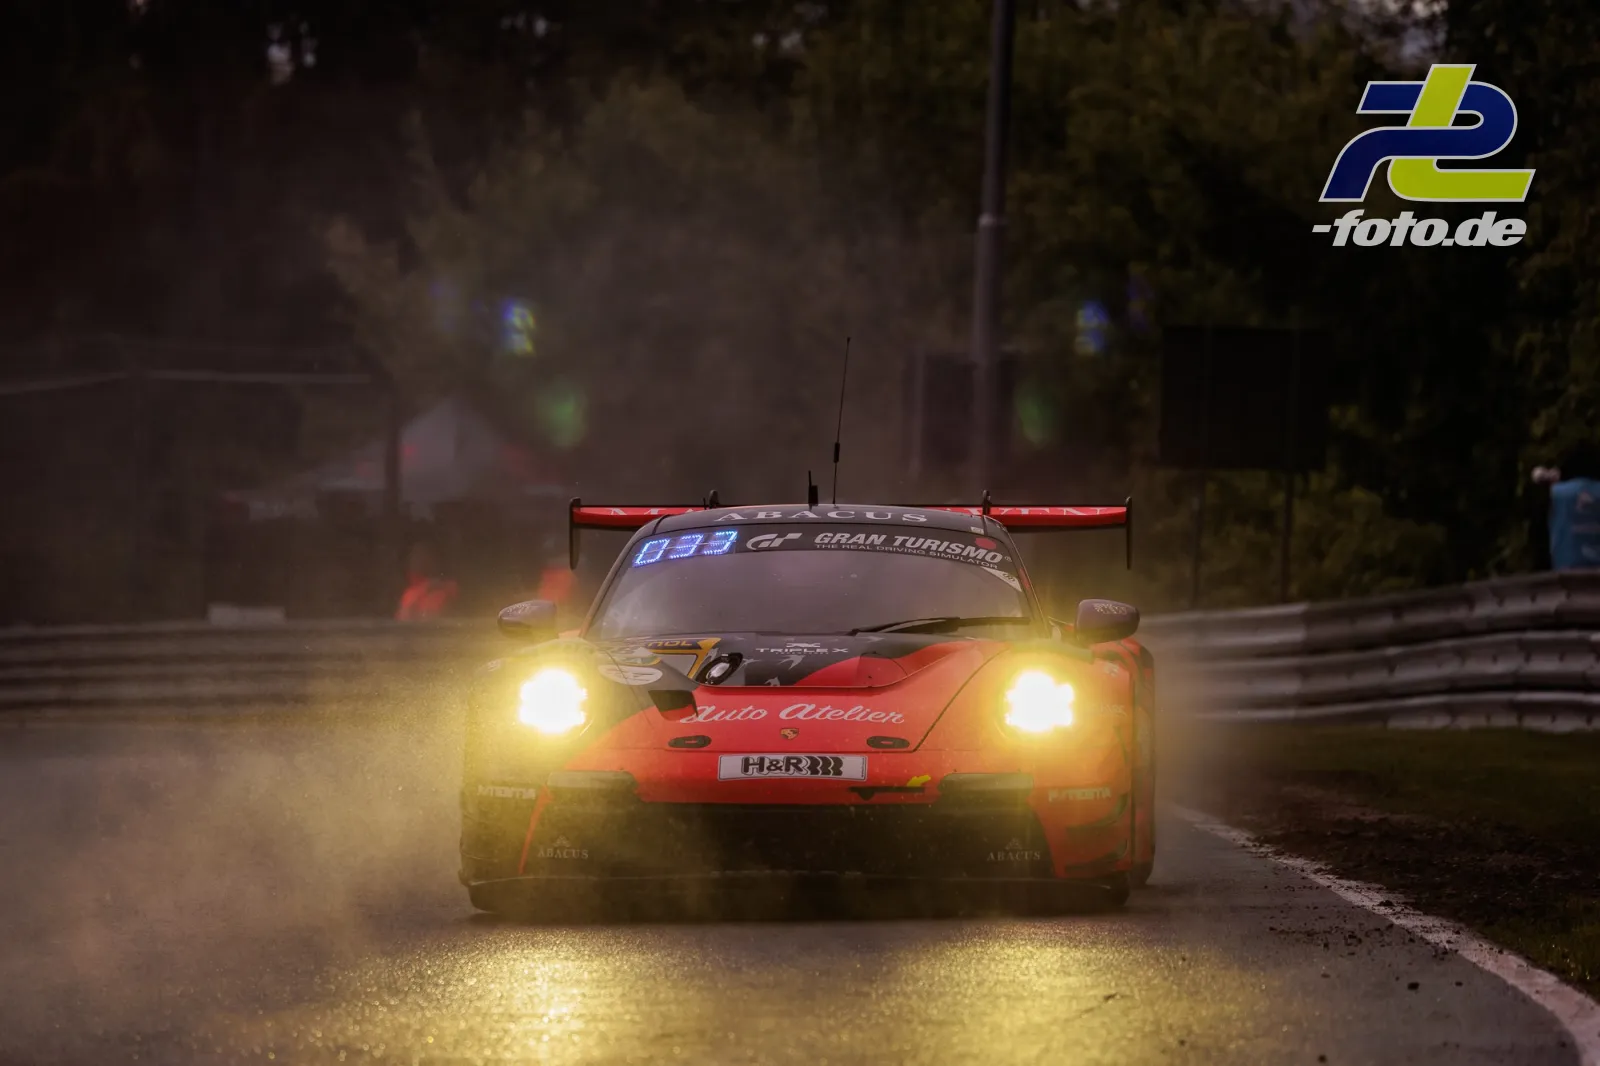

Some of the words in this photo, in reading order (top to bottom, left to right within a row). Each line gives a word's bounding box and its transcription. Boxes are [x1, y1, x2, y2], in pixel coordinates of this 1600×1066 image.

[714, 510, 928, 523] ABACUS
[814, 532, 888, 546] GRAN
[892, 535, 1003, 564] TURISMO
[876, 546, 927, 555] DRIVING
[929, 551, 999, 570] SIMULATOR
[680, 705, 769, 724] Auto
[778, 703, 905, 724] Atelier
[742, 756, 805, 775] H&R
[537, 849, 590, 860] ABACUS
[986, 851, 1042, 862] ABACUS
